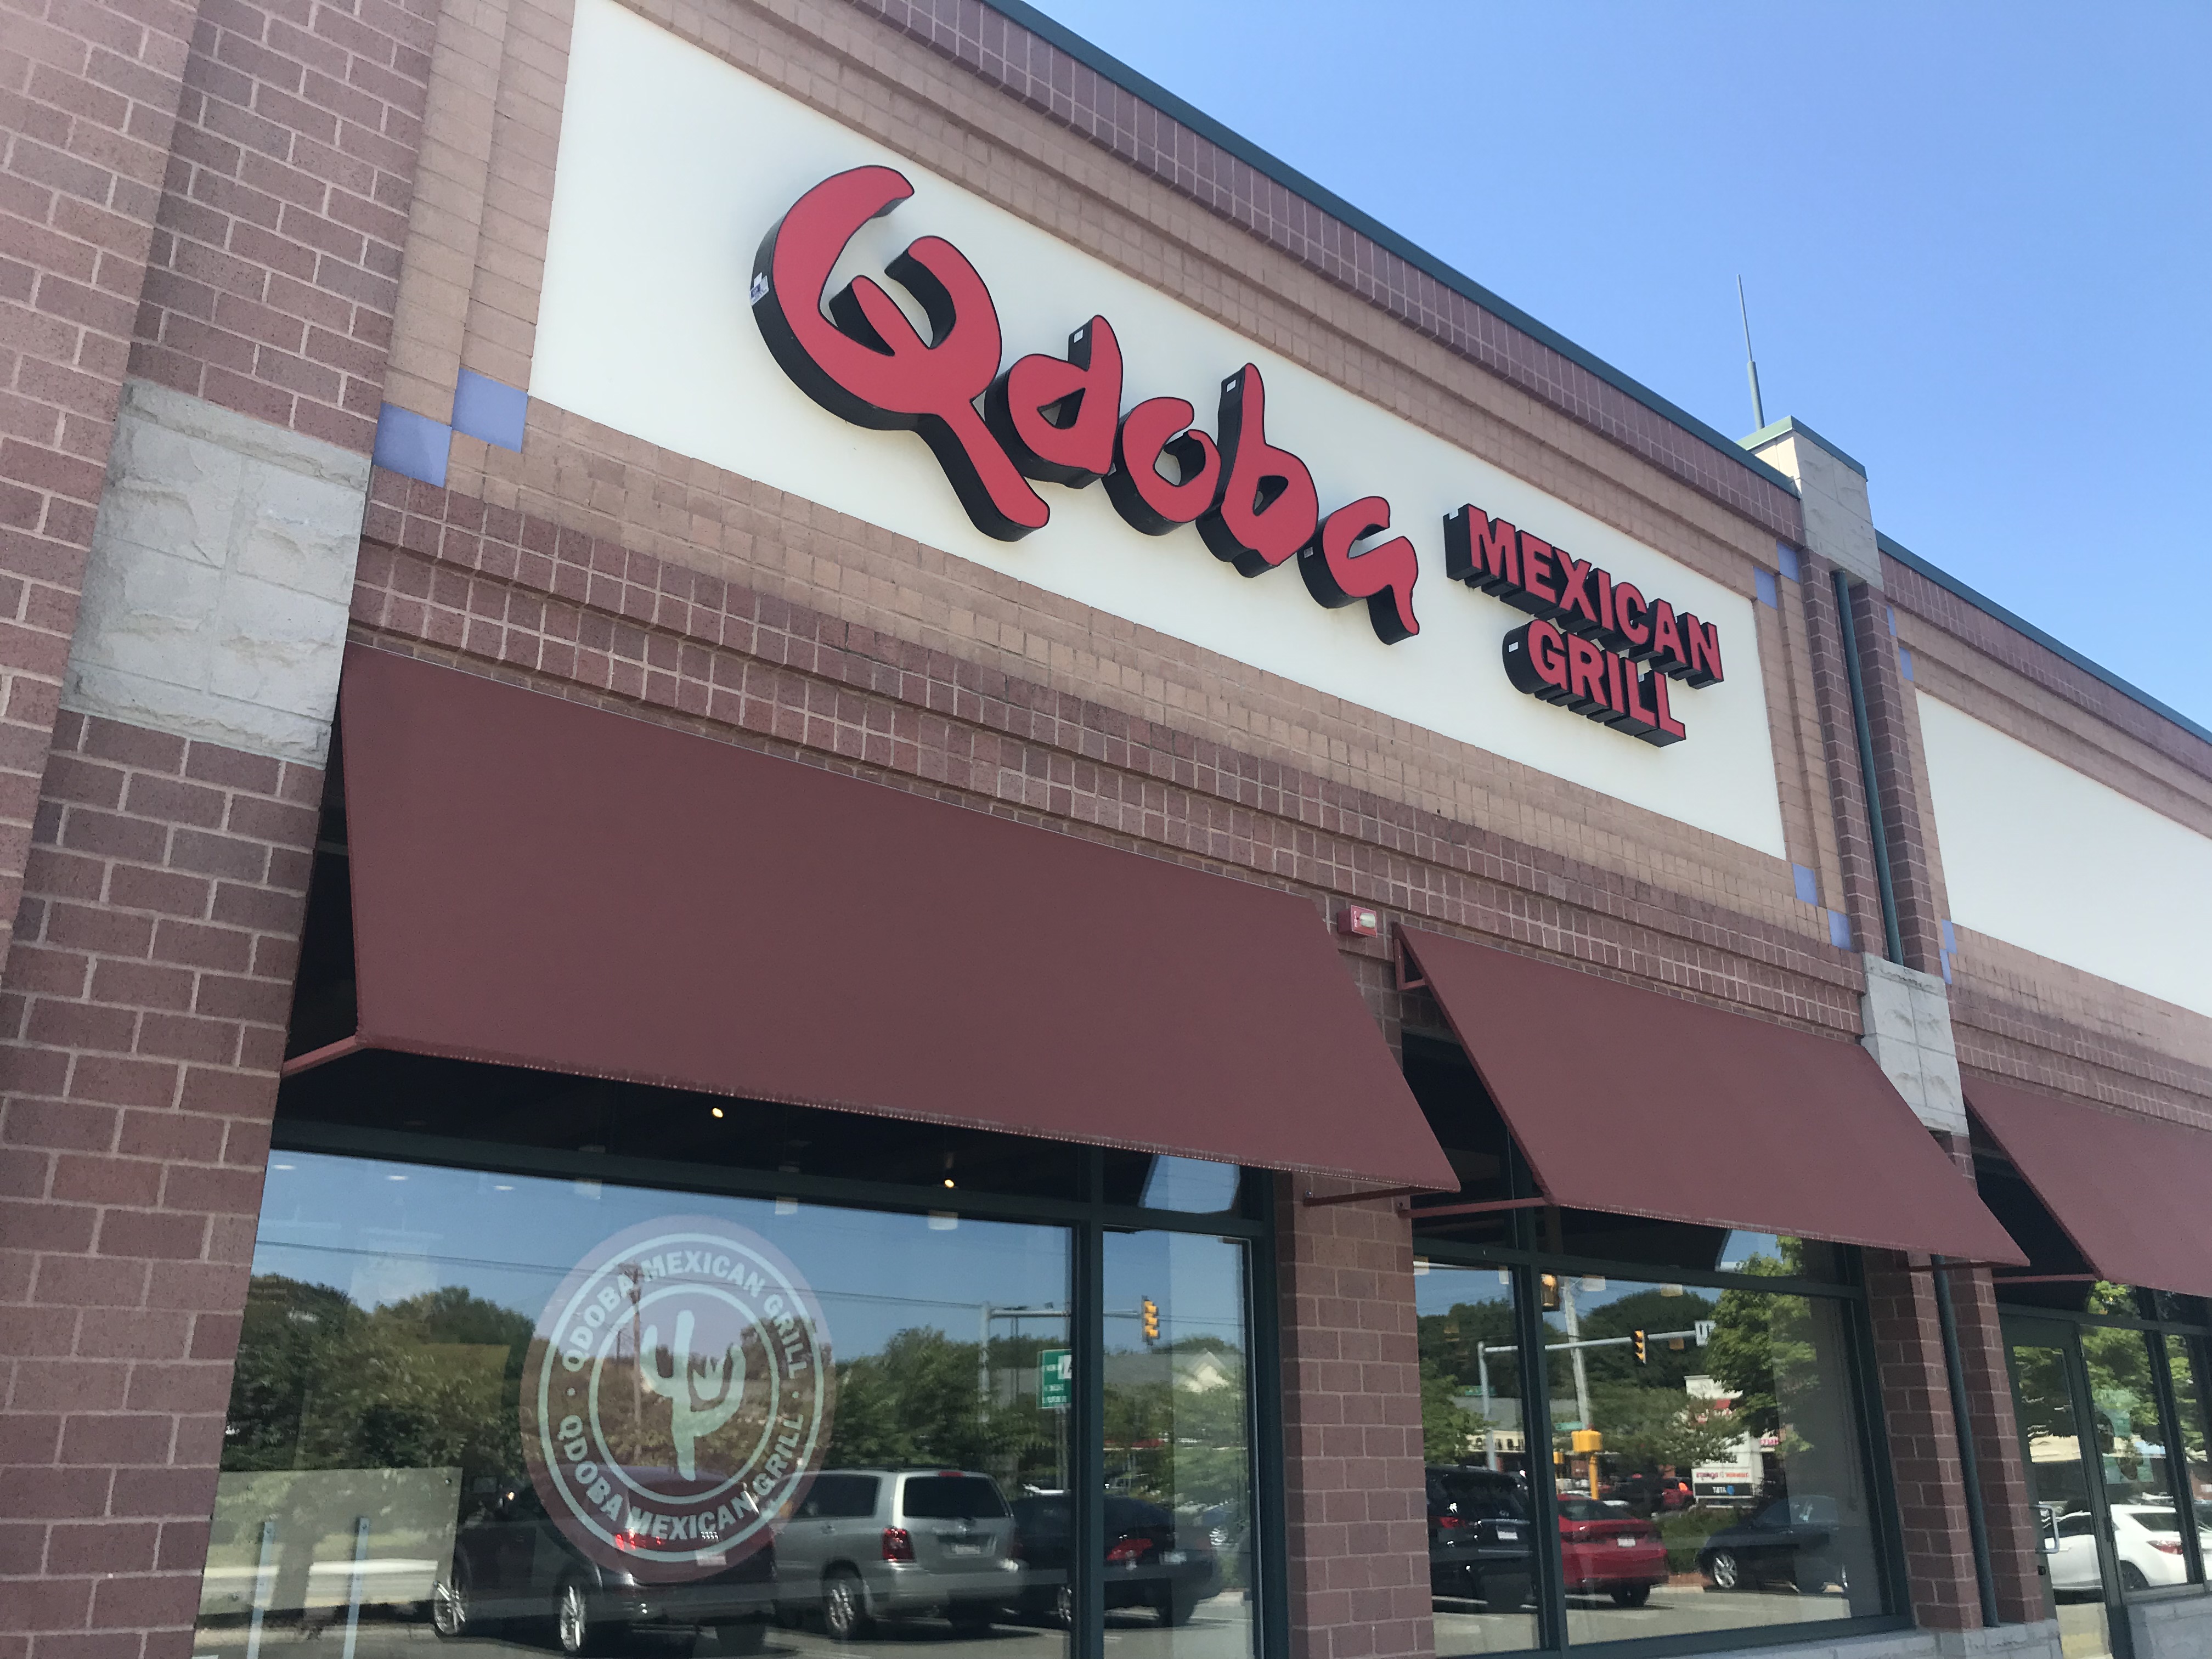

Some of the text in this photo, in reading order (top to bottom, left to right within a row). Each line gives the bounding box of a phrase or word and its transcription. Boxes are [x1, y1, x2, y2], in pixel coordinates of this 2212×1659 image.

[768, 165, 1419, 643] Qdoba
[1466, 504, 1724, 682] MEXICAN
[1525, 618, 1686, 741] GRILL
[562, 1250, 807, 1379] QDOBA MEXICAN GRILL
[557, 1413, 804, 1541] QDOBA MEXICAN GRILL
